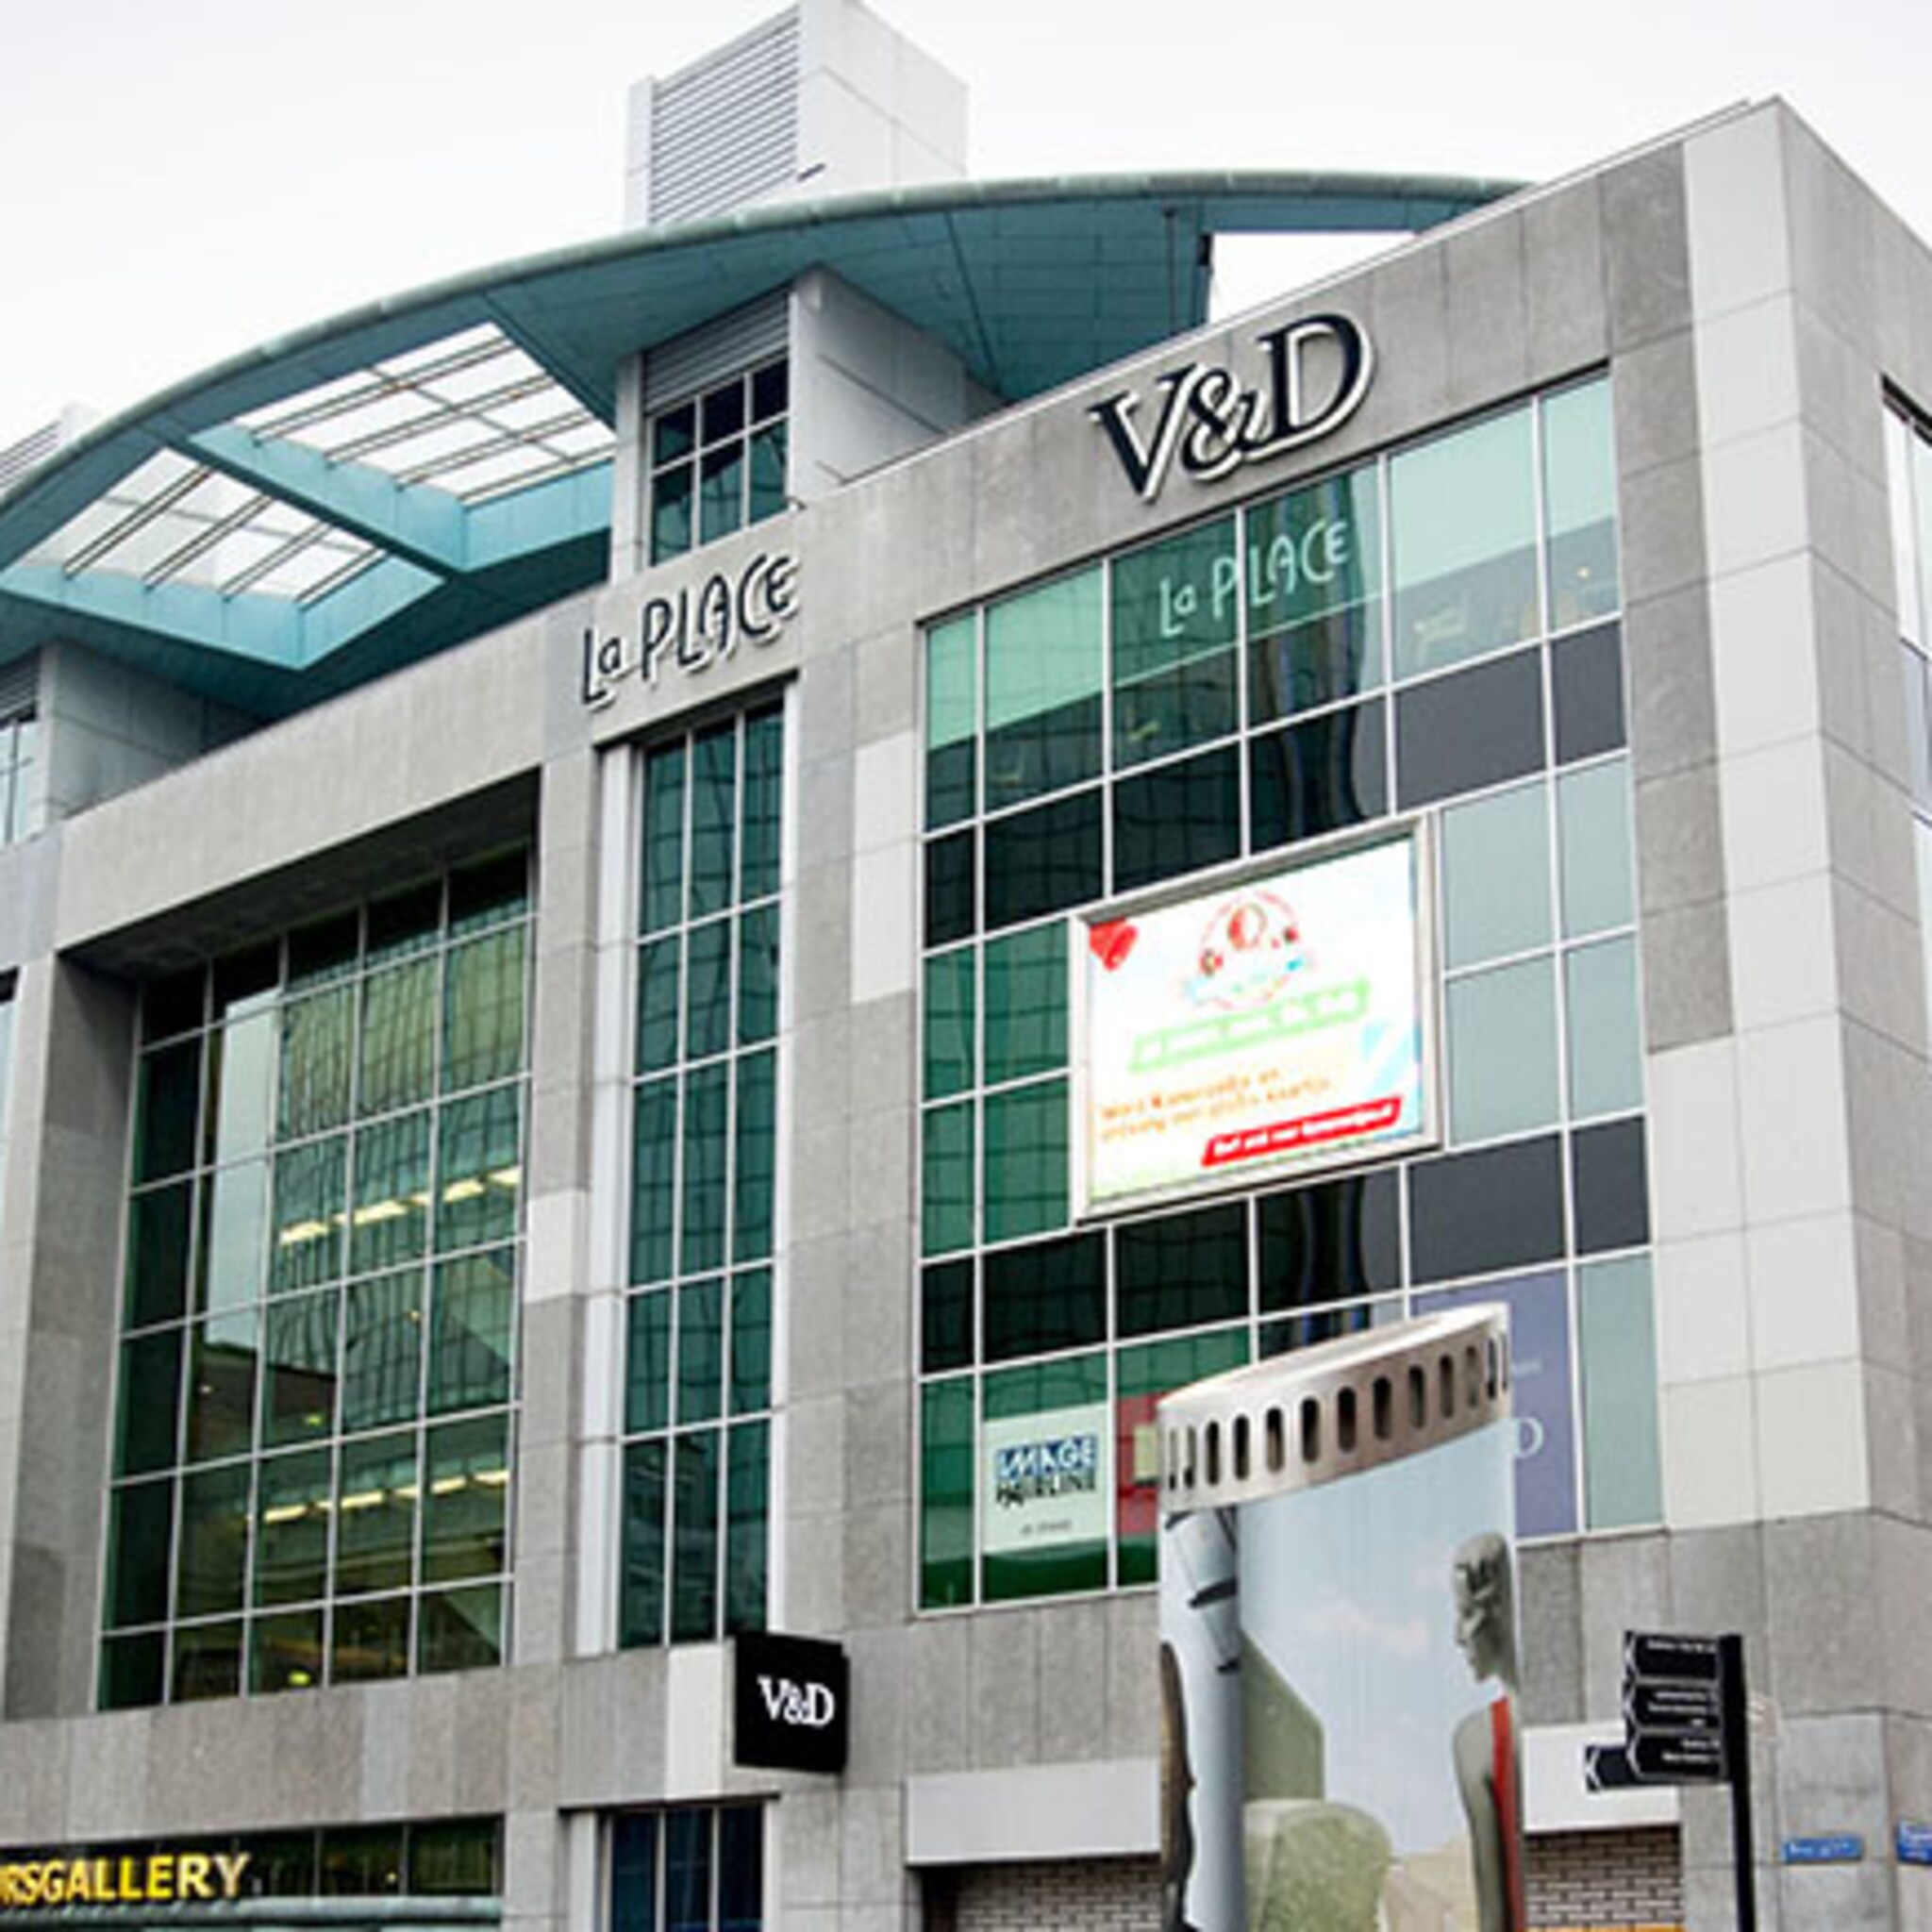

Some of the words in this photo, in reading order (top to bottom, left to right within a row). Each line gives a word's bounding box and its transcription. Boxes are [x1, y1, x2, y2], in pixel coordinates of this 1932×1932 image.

[1088, 312, 1373, 500] V&D
[582, 627, 636, 710] La
[641, 554, 800, 689] PLACE
[1159, 577, 1196, 638] La
[1212, 520, 1348, 618] PLACE
[757, 1674, 835, 1728] V&D
